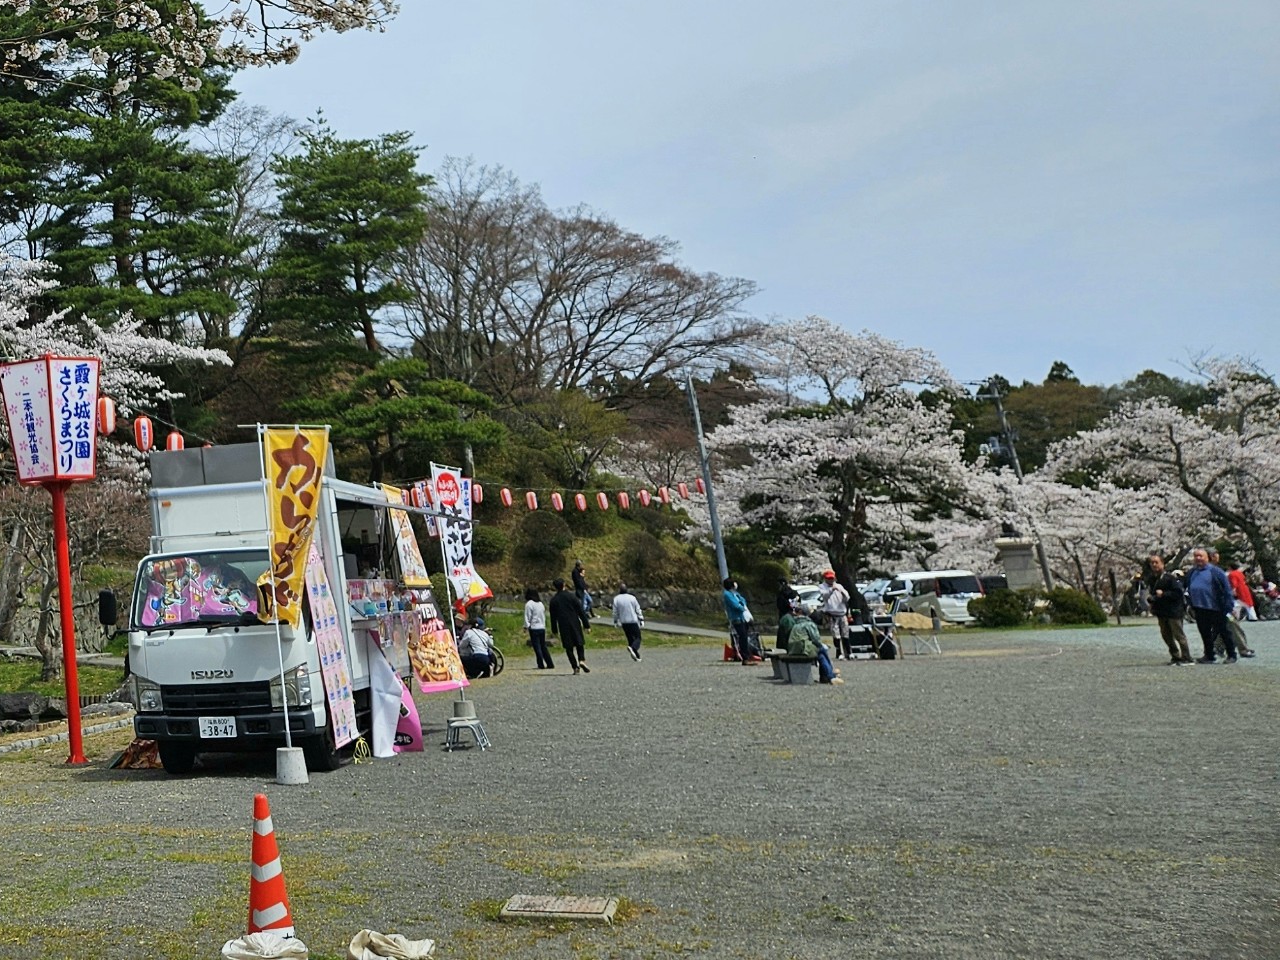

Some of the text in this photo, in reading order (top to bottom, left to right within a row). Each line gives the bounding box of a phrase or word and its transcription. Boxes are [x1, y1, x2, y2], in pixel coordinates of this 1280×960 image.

[22, 392, 40, 465] 二本松観光協会
[59, 365, 74, 473] さくらまつり
[73, 363, 91, 458] 霞ヶ城公園
[190, 669, 234, 680] ISUZU
[207, 724, 234, 737] 38-47
